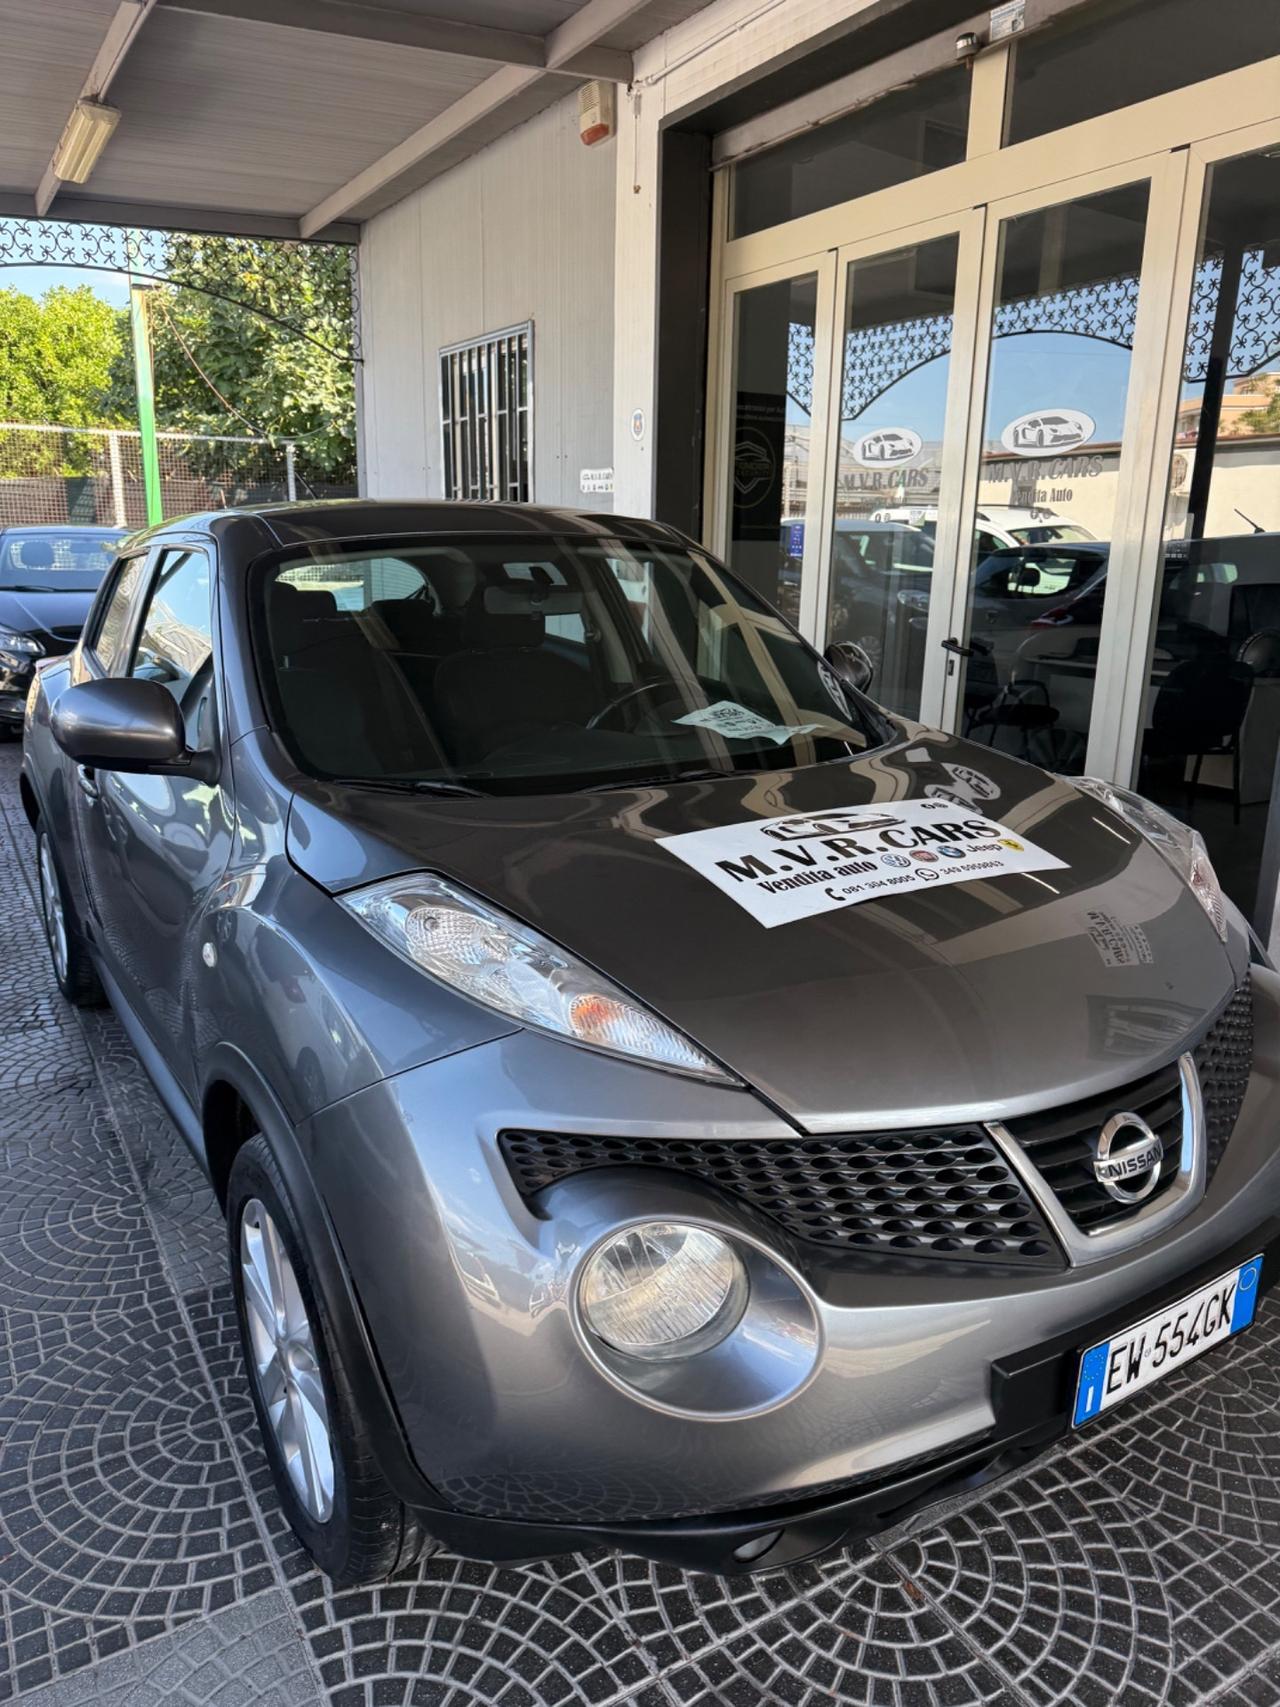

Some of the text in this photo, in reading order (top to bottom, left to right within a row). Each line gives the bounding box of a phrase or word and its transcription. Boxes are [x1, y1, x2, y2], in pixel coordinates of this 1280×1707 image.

[1050, 487, 1073, 502] Auto
[714, 819, 1002, 883] M.V.R.CARS
[966, 844, 1003, 854] Jeep
[833, 860, 879, 877] auto
[1108, 1146, 1161, 1177] NISSAN
[1106, 1334, 1146, 1394] EW
